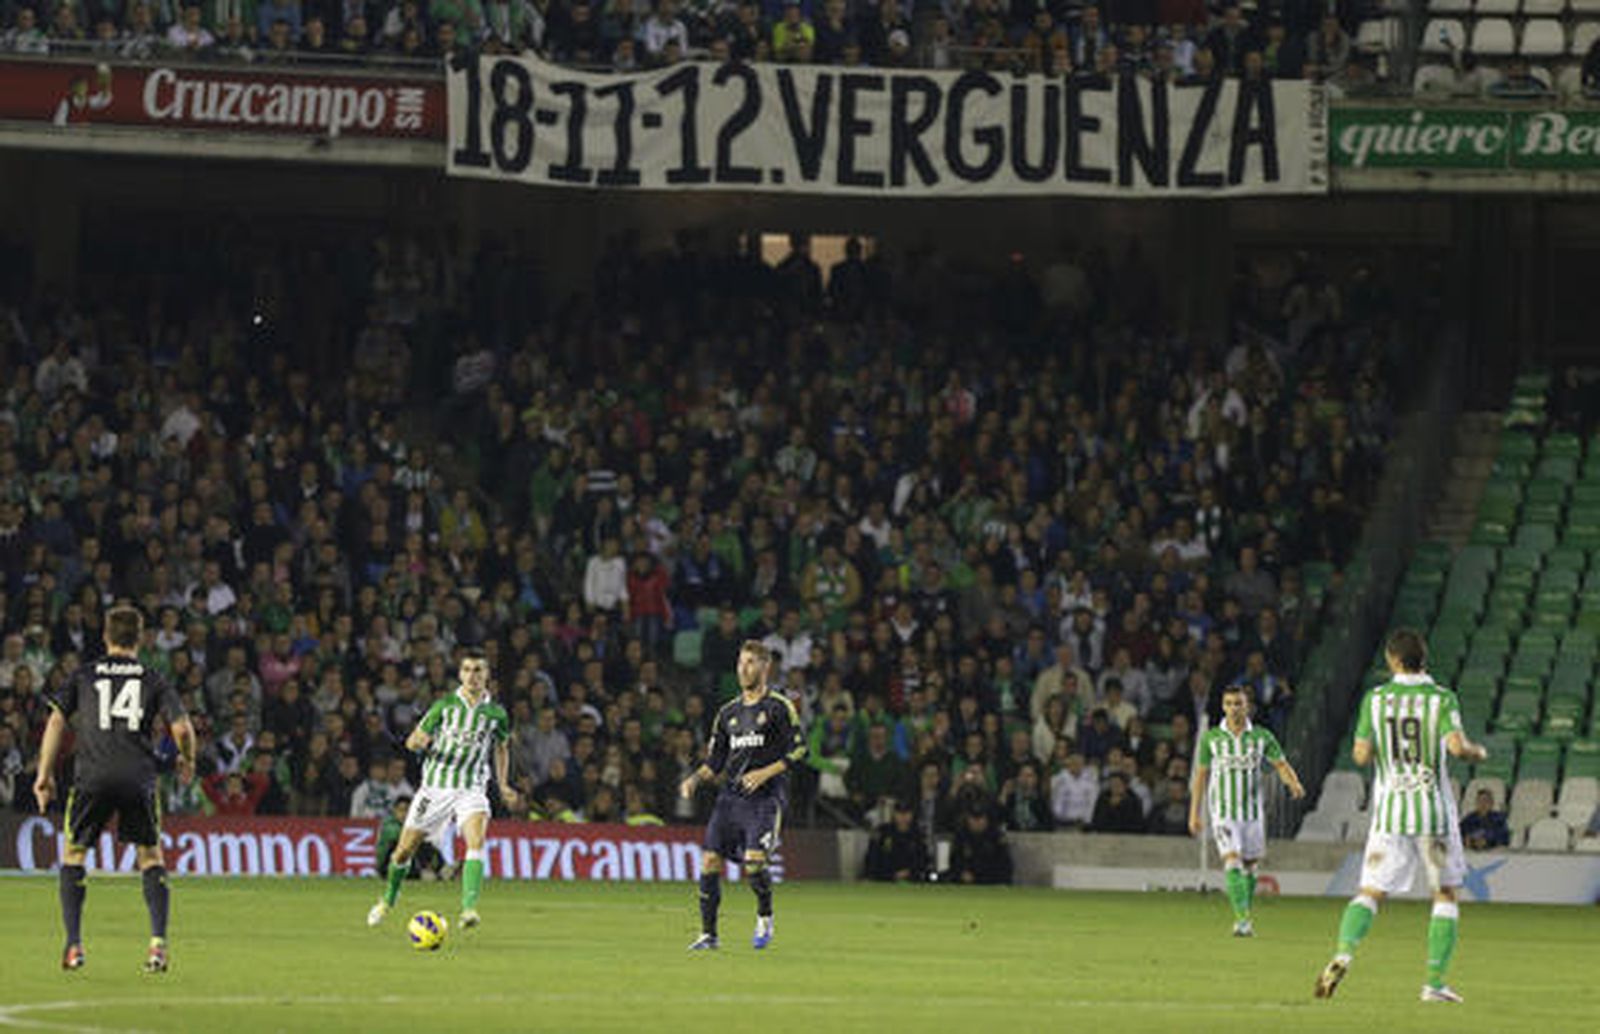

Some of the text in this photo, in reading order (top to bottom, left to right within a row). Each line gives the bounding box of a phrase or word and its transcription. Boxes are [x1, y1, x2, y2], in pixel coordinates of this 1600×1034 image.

[143, 68, 386, 138] Cruzcampo
[395, 87, 426, 129] SIN
[1338, 110, 1504, 168] quiero
[94, 678, 144, 731] 14
[1387, 717, 1422, 764] 19
